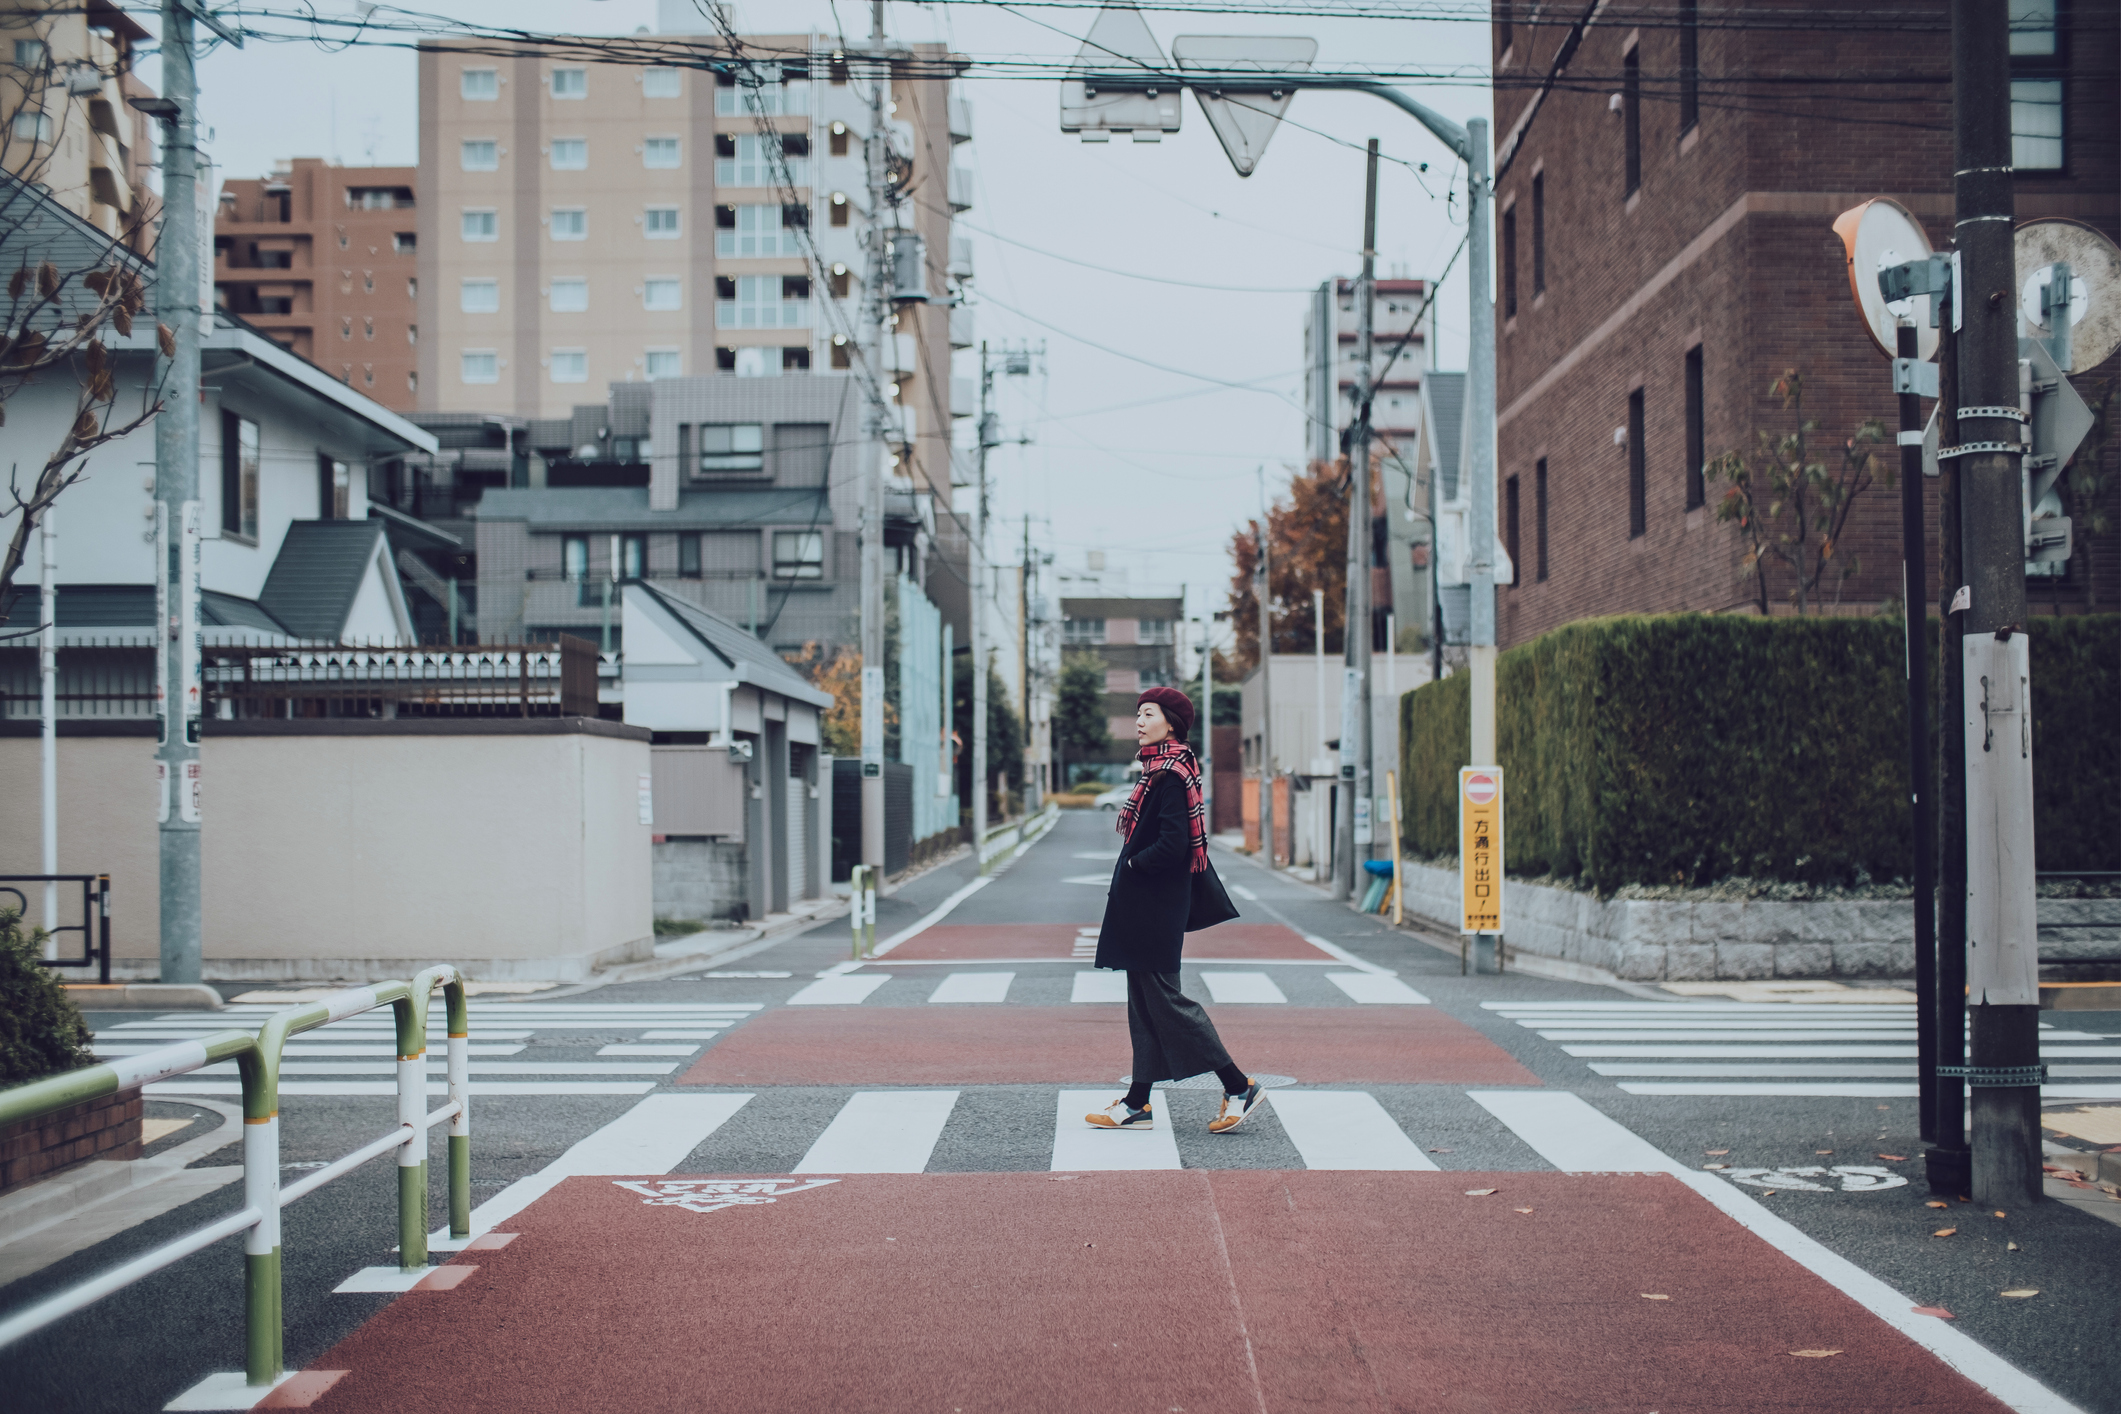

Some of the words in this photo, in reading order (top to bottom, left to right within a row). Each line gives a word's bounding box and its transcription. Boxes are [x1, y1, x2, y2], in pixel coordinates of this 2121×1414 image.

[1474, 810, 1490, 912] 一方通行出口!
